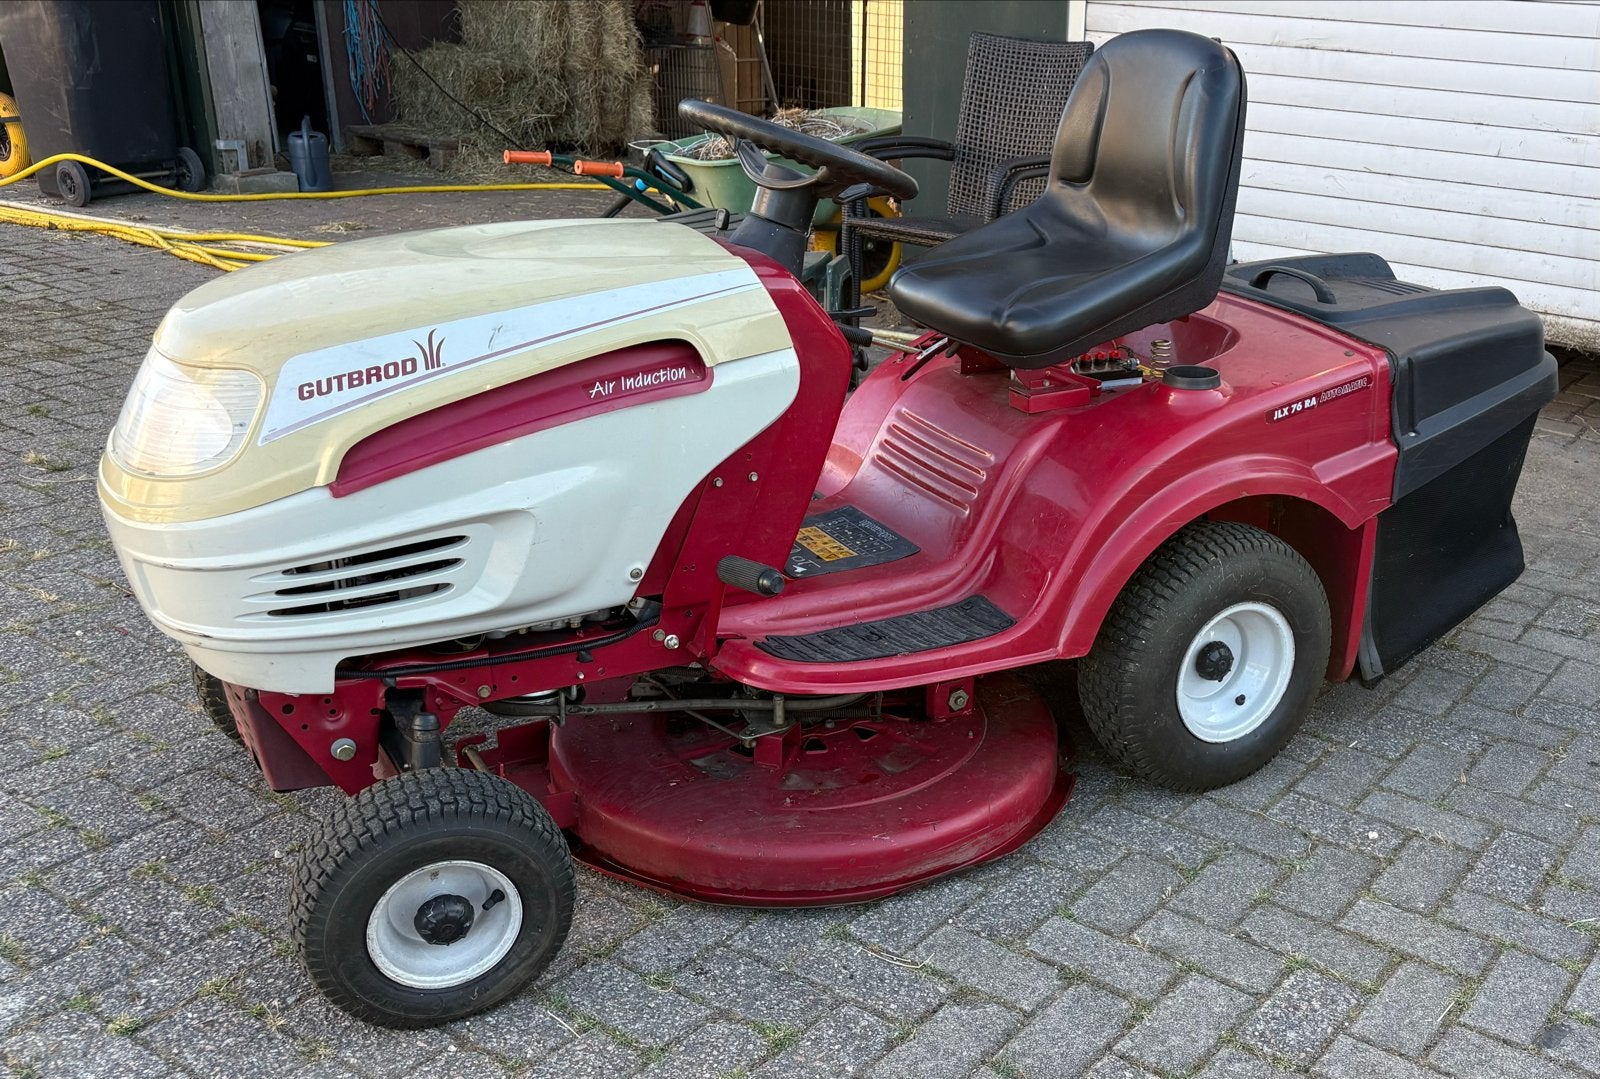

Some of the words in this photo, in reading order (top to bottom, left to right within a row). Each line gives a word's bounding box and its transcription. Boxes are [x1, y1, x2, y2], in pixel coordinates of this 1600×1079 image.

[298, 357, 417, 401] GUTBROD
[589, 381, 616, 398] Air
[621, 367, 686, 390] Induction
[1273, 407, 1289, 420] JLX
[1291, 401, 1303, 413] 76
[1304, 396, 1317, 409] RA
[1320, 377, 1367, 402] AUTOMATIC
